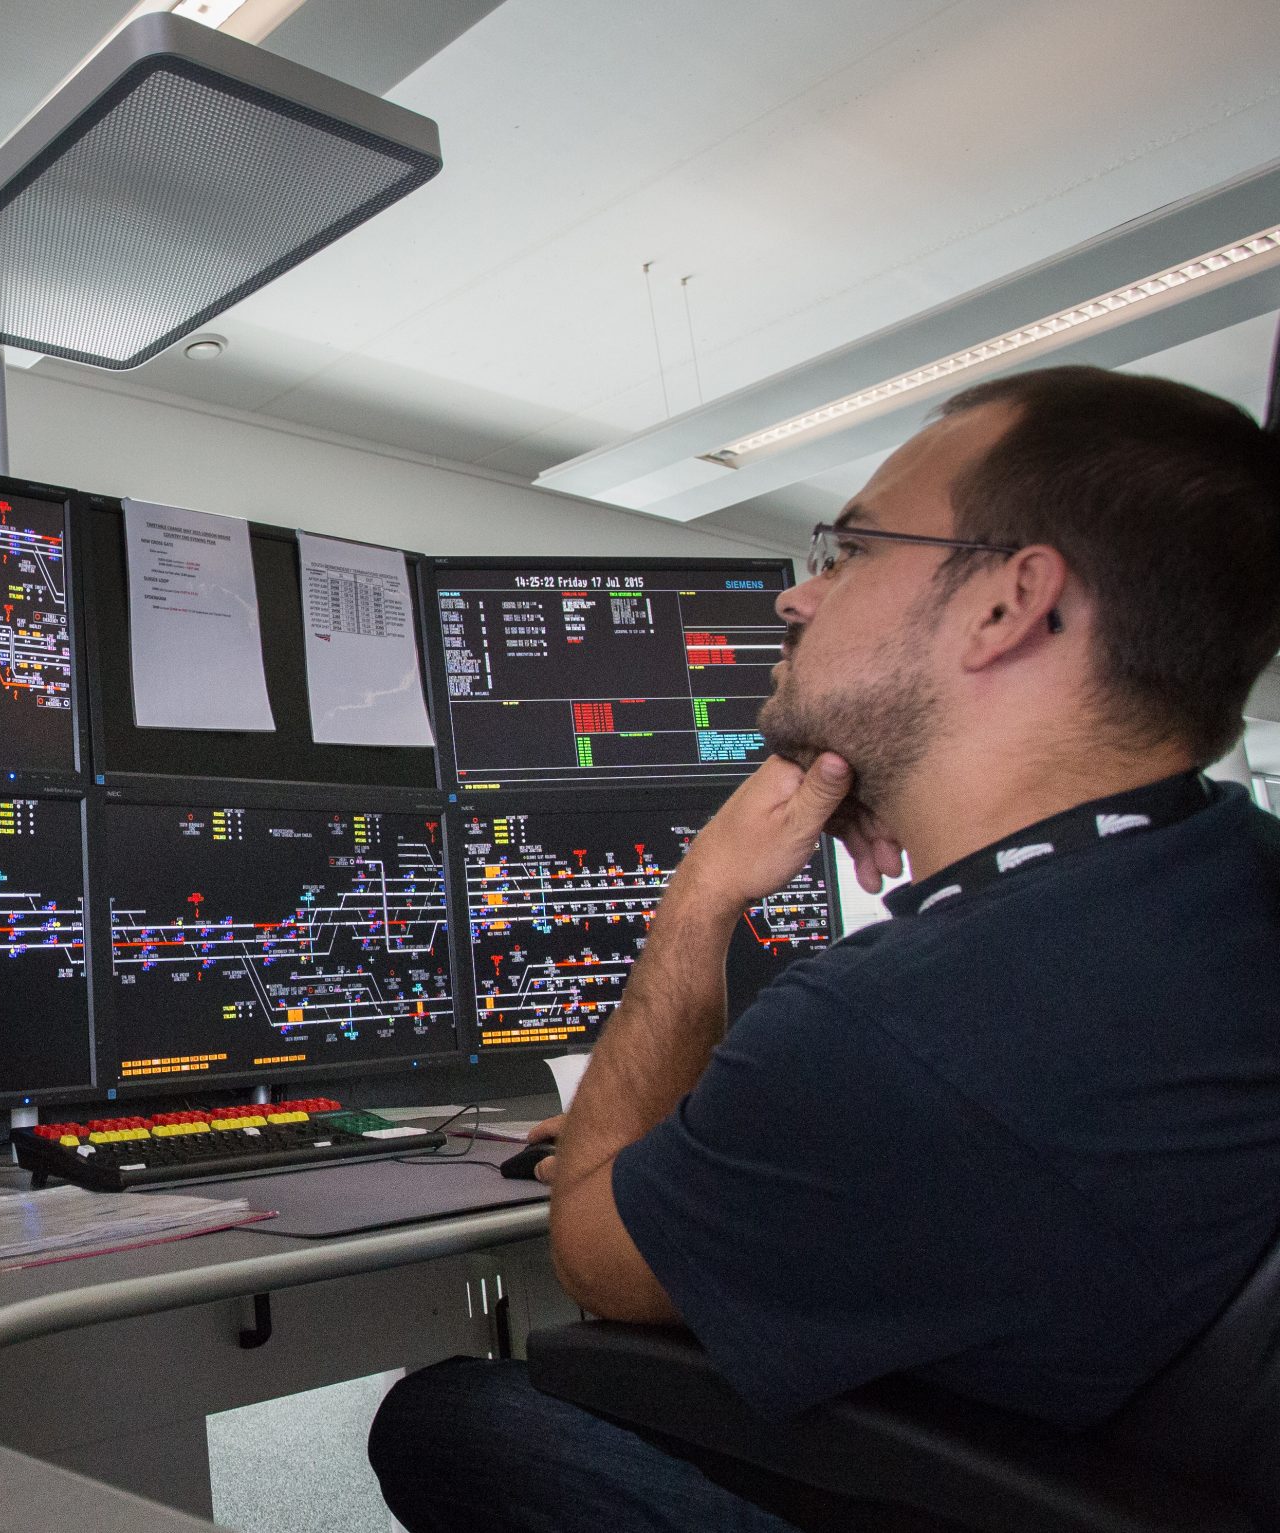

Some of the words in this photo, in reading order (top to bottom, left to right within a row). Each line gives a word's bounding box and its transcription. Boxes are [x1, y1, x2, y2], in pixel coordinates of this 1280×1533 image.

[515, 577, 554, 587] 14:25:22
[558, 577, 587, 588] Friday
[591, 577, 601, 587] 17
[606, 577, 620, 588] Jul
[624, 577, 644, 588] 2015
[725, 580, 763, 589] SIEMENS
